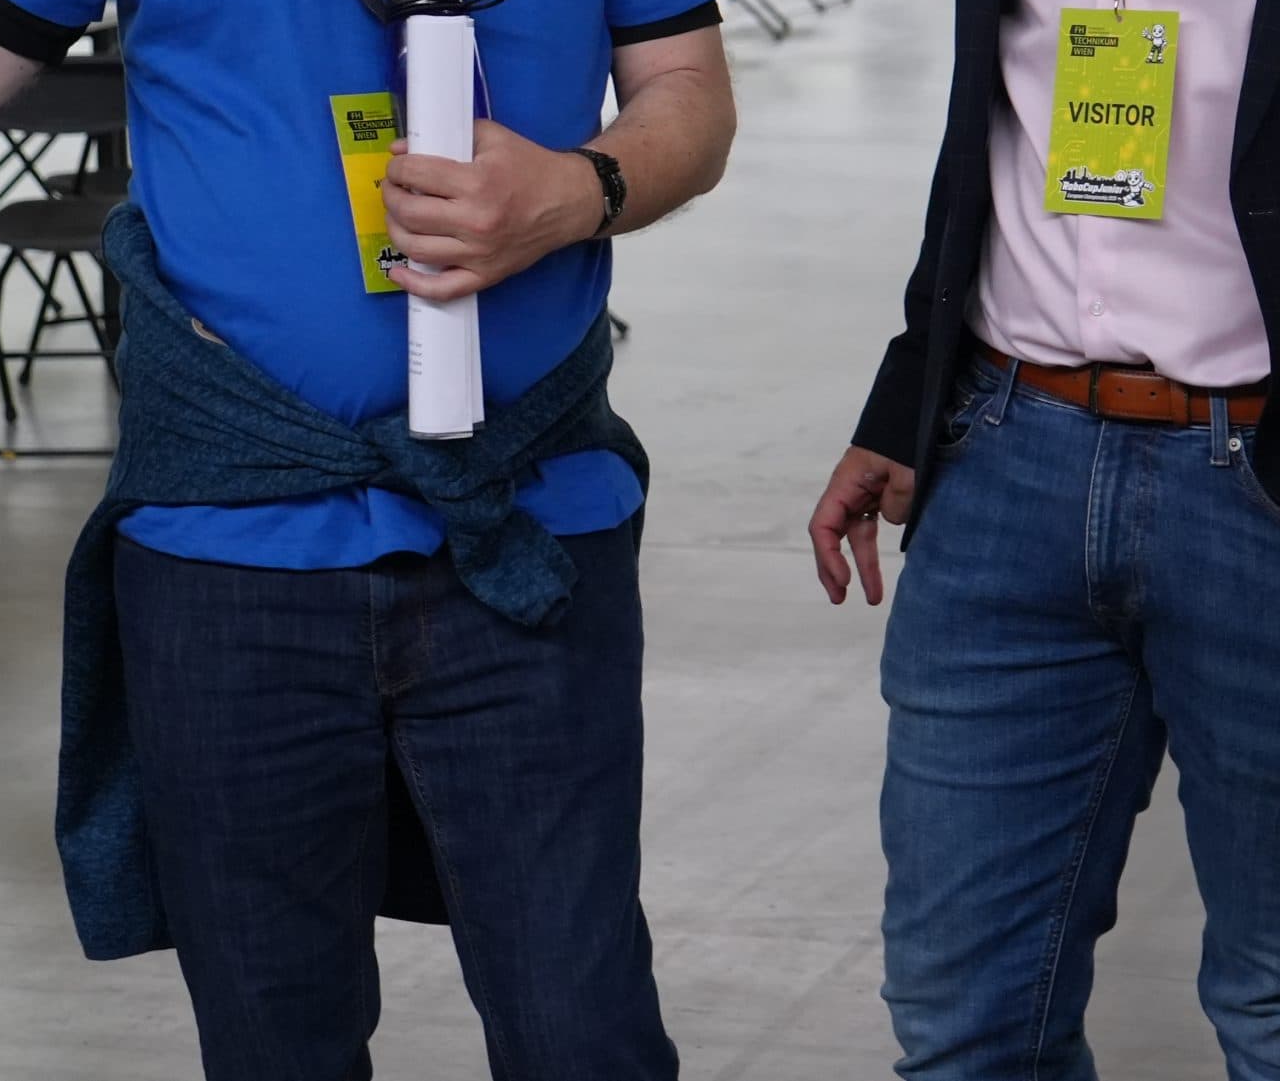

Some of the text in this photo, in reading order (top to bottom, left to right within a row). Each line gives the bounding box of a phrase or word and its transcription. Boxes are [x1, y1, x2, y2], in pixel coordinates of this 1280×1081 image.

[1074, 36, 1117, 46] TECHNIKUM
[1073, 47, 1093, 56] WIEN
[1068, 101, 1155, 127] VISITOR
[355, 131, 376, 140] WIEN
